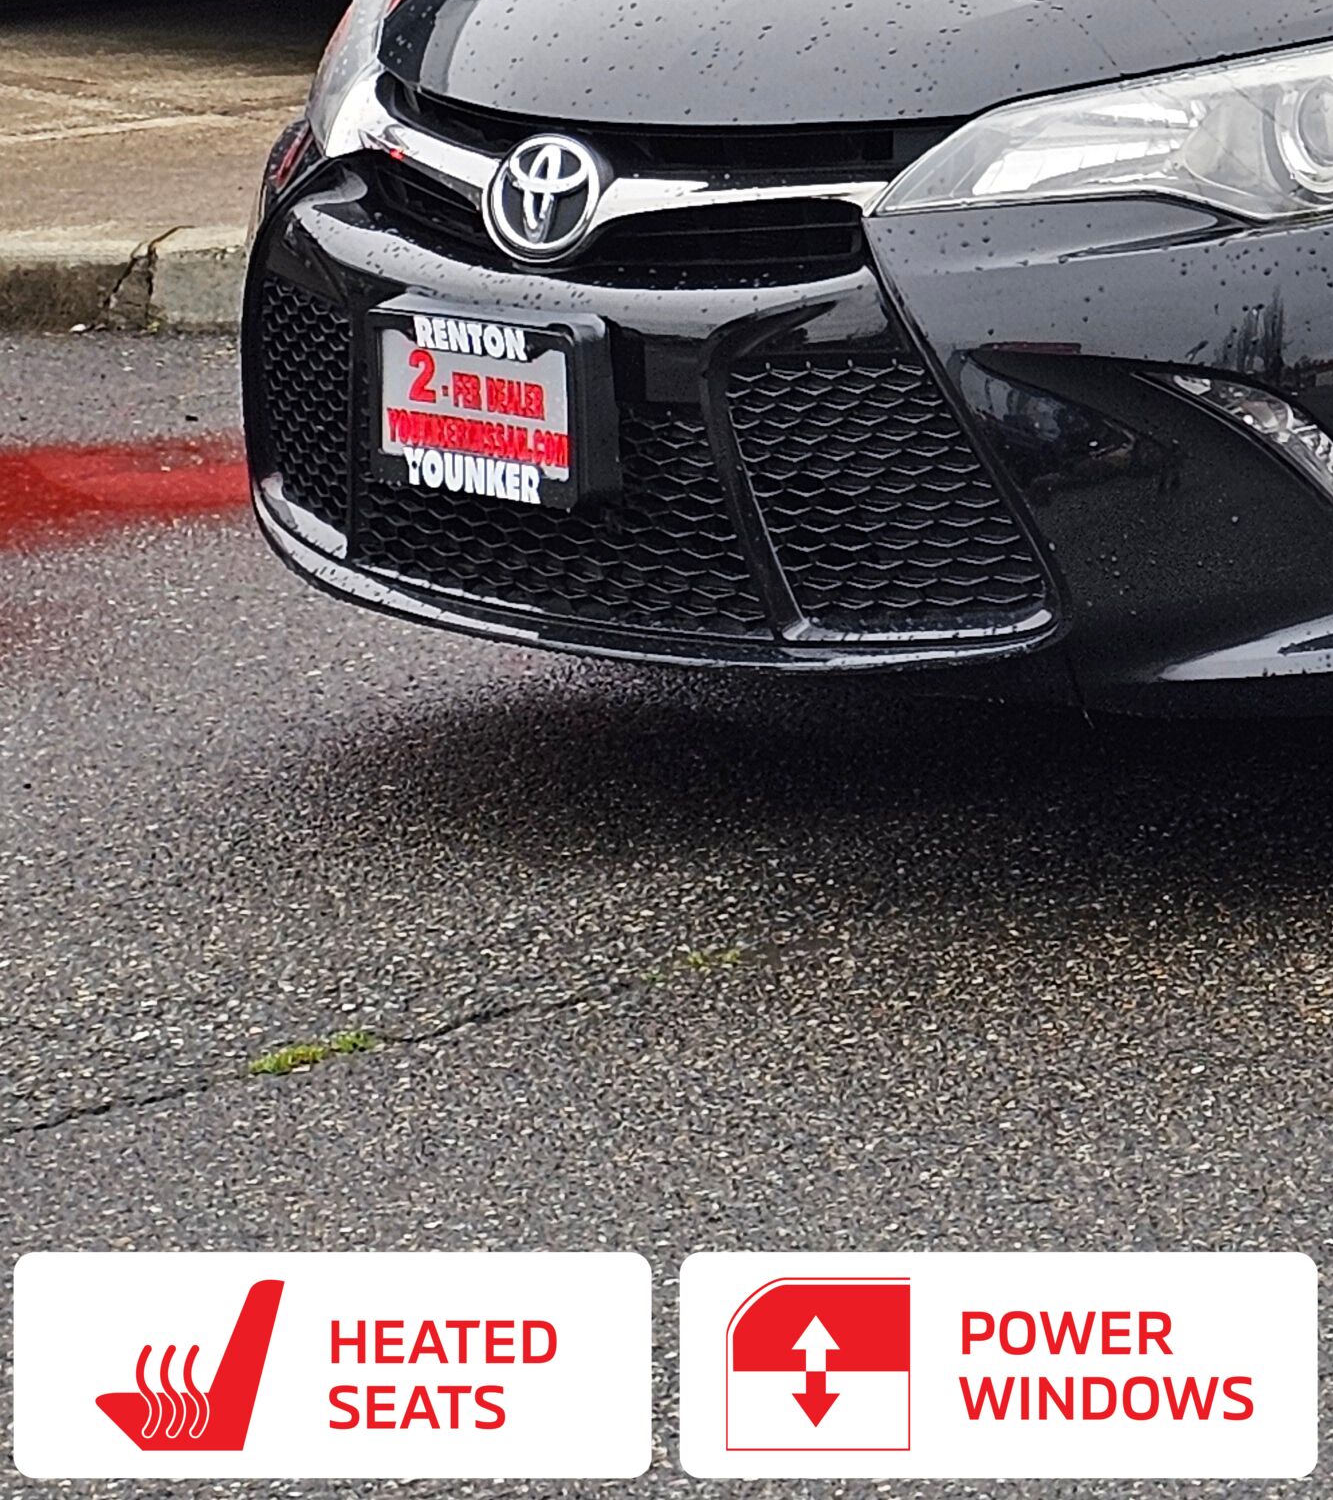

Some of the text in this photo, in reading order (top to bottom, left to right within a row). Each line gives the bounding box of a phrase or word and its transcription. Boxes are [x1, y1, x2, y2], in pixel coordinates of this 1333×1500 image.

[413, 315, 528, 362] RENTON
[408, 348, 437, 404] 2
[452, 371, 483, 411] PER
[485, 376, 546, 422] DEALER
[386, 406, 570, 470] YOUNKERNISSAN.COM
[402, 446, 542, 505] YOUNKER
